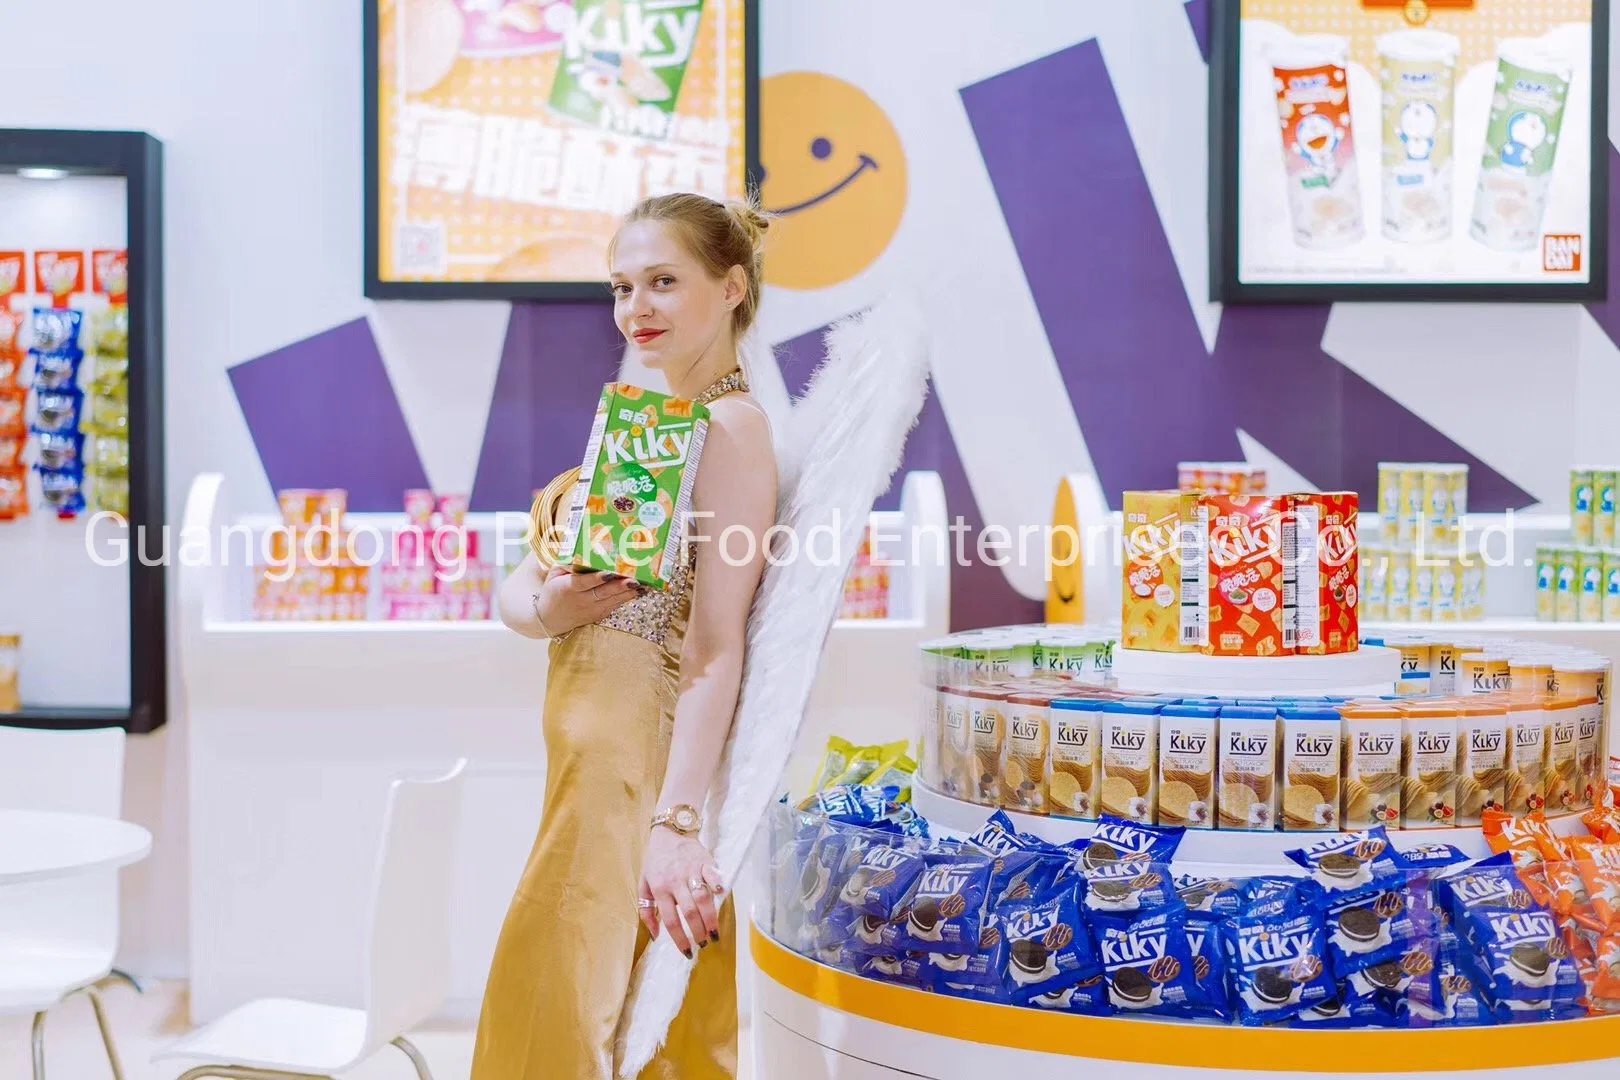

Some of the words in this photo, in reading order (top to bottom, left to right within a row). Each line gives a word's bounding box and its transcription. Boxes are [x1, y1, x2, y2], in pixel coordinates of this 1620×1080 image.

[604, 424, 693, 469] Kiky
[1121, 516, 1181, 560] Kiky
[1209, 515, 1281, 567] Kiky
[1049, 657, 1084, 675] Kiky
[974, 715, 995, 734] Kiky
[1012, 721, 1038, 740] Kiky
[1057, 727, 1088, 746] Kiky
[1111, 731, 1146, 750] Kiky
[1169, 735, 1206, 754] Kiky
[1417, 736, 1451, 754] Kiky
[1472, 734, 1501, 752] Kiky
[1516, 728, 1540, 747] Kiky
[1554, 726, 1574, 745] Kiky
[1229, 737, 1268, 755] Kiky
[1294, 738, 1333, 756] Kiky
[1358, 737, 1394, 755] Kiky
[966, 821, 1022, 858] Kiky
[1090, 824, 1158, 854] Kiky
[915, 870, 969, 898] Kiky
[1449, 876, 1513, 907] Kiky
[1006, 905, 1061, 943] Kiky
[1490, 912, 1556, 949] Kiky
[1101, 929, 1167, 972] Kiky
[1239, 932, 1311, 972] Kiky
